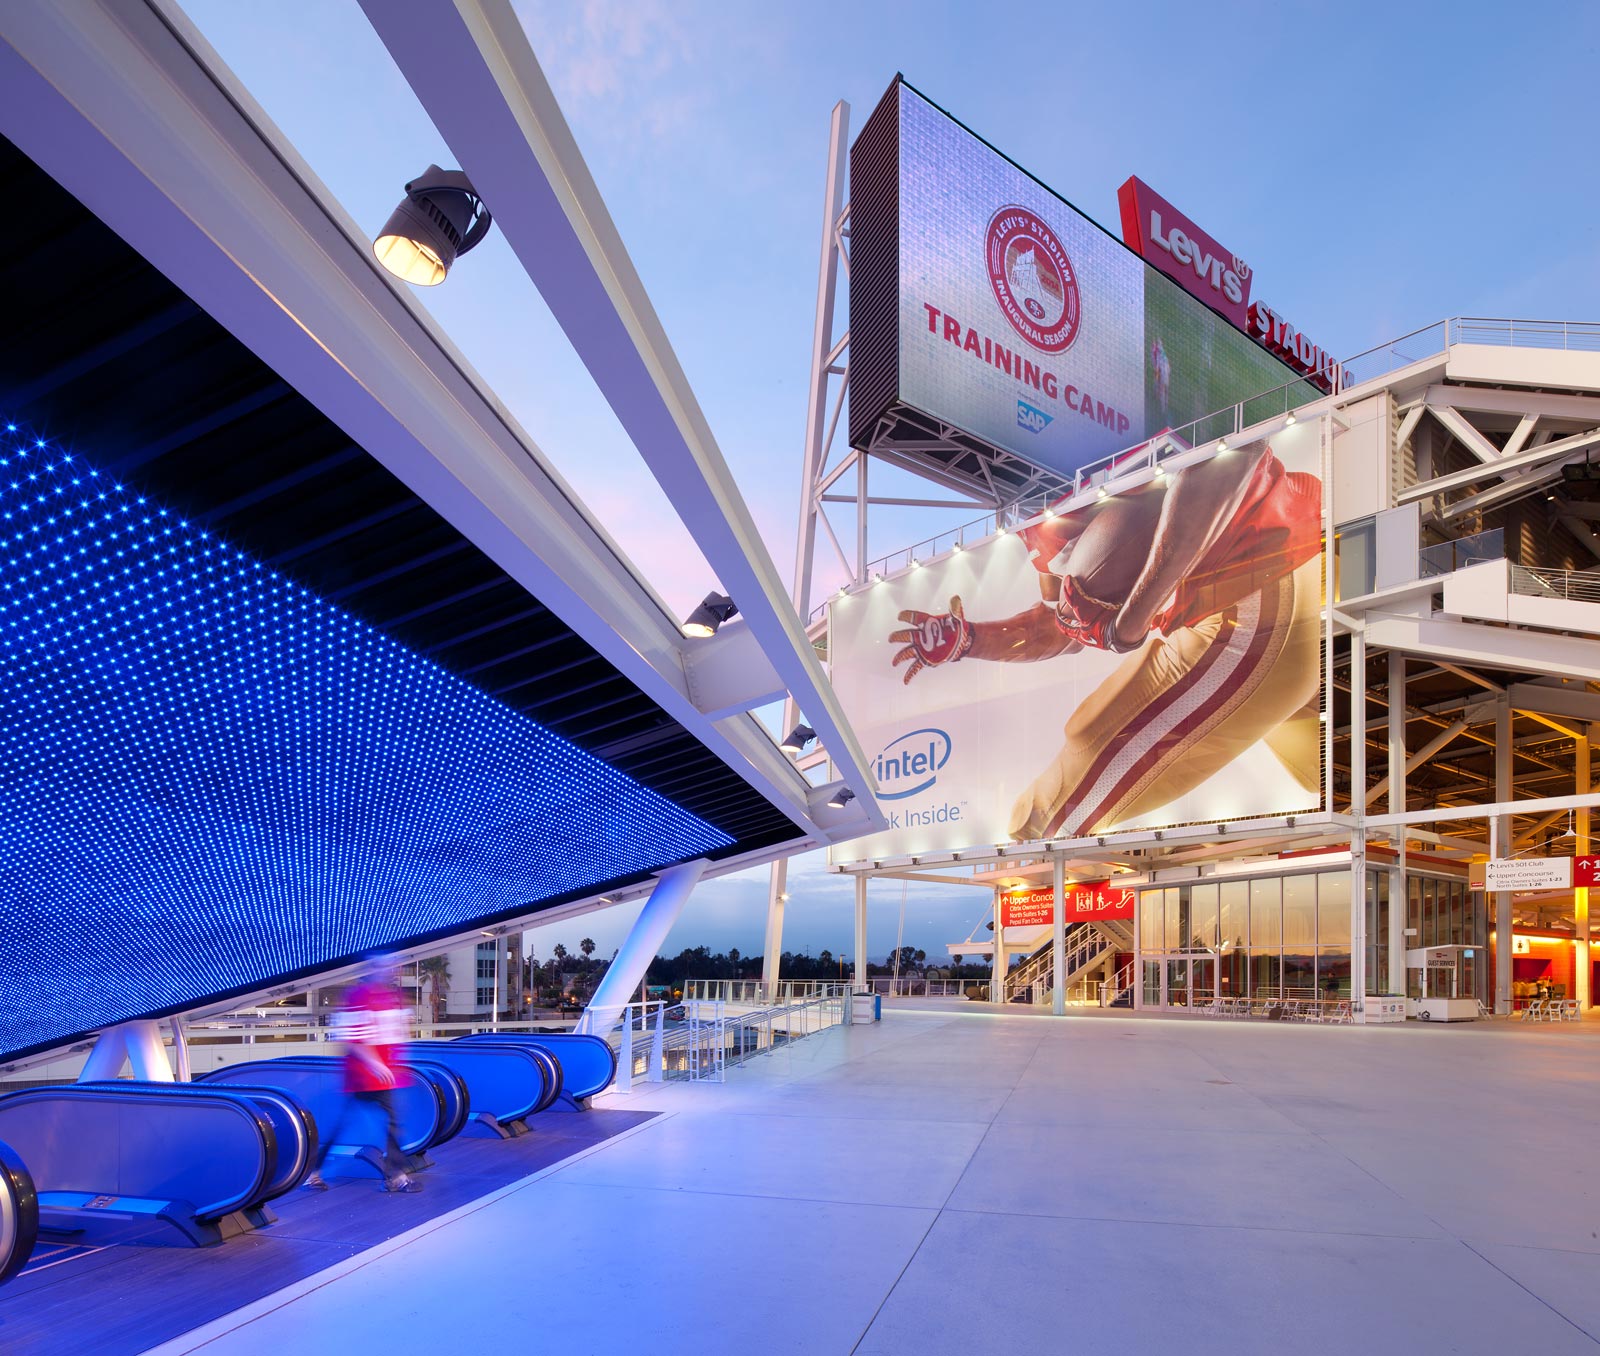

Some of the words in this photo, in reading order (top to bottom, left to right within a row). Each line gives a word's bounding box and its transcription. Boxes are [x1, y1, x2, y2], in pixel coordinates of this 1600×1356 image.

[1031, 222, 1072, 282] STADIUM
[996, 280, 1044, 344] INAUGURAL
[1043, 321, 1073, 345] SEASON
[924, 302, 1058, 400] TRAINING
[1063, 384, 1131, 436] CAMP
[1255, 299, 1354, 389] STADIUM
[1018, 405, 1046, 432] SAP
[877, 742, 935, 782] intel
[1009, 896, 1030, 905] Upper
